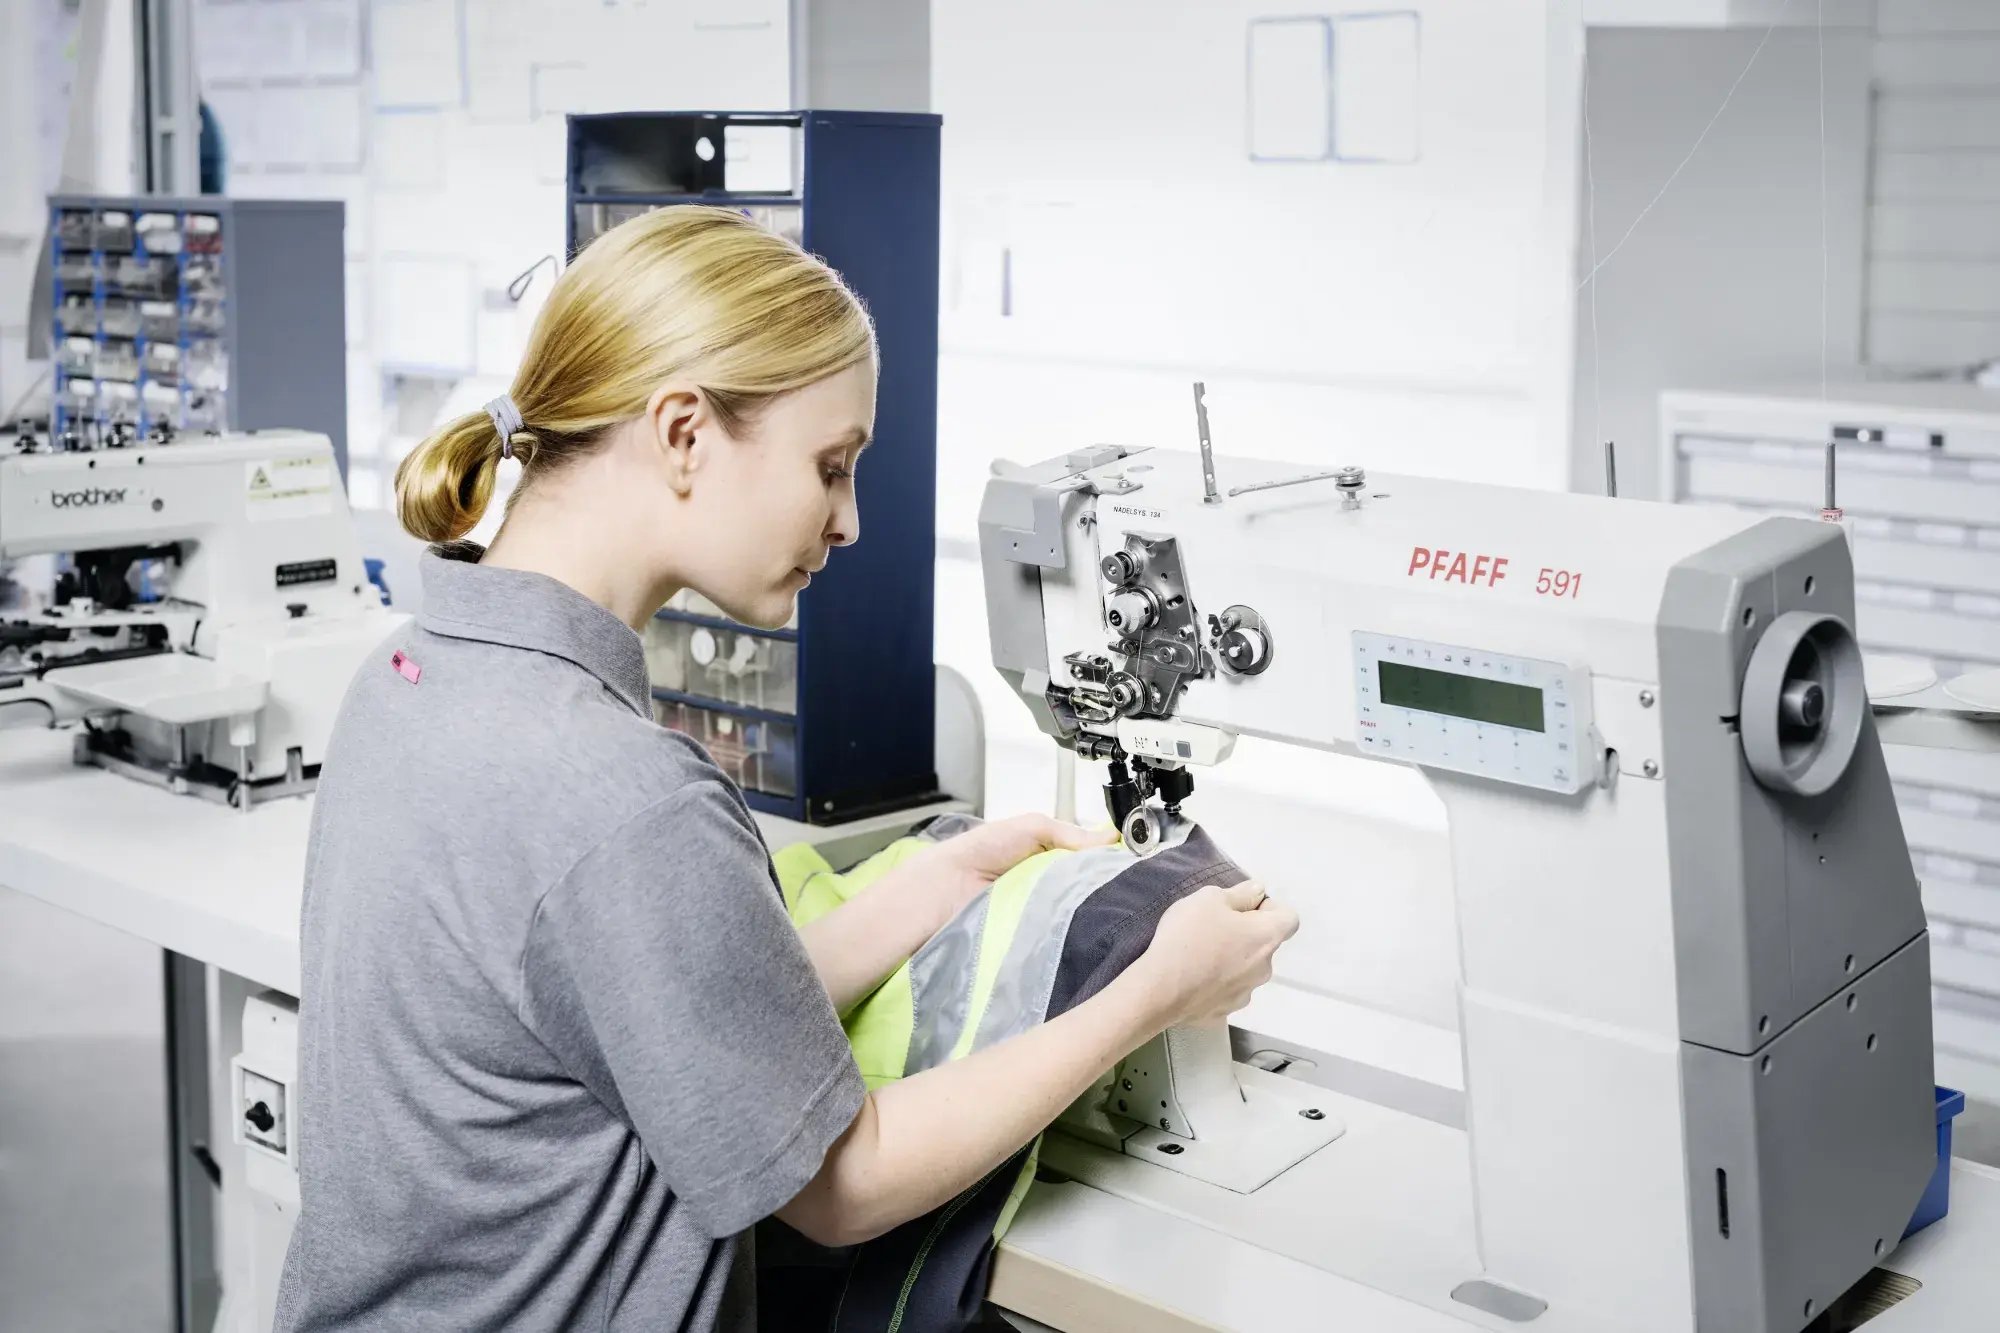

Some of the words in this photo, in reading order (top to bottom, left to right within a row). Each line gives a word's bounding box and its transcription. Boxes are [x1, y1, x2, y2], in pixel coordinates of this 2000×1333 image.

[51, 487, 128, 508] brother
[1408, 547, 1509, 587] PFAFF
[1536, 568, 1582, 600] 591
